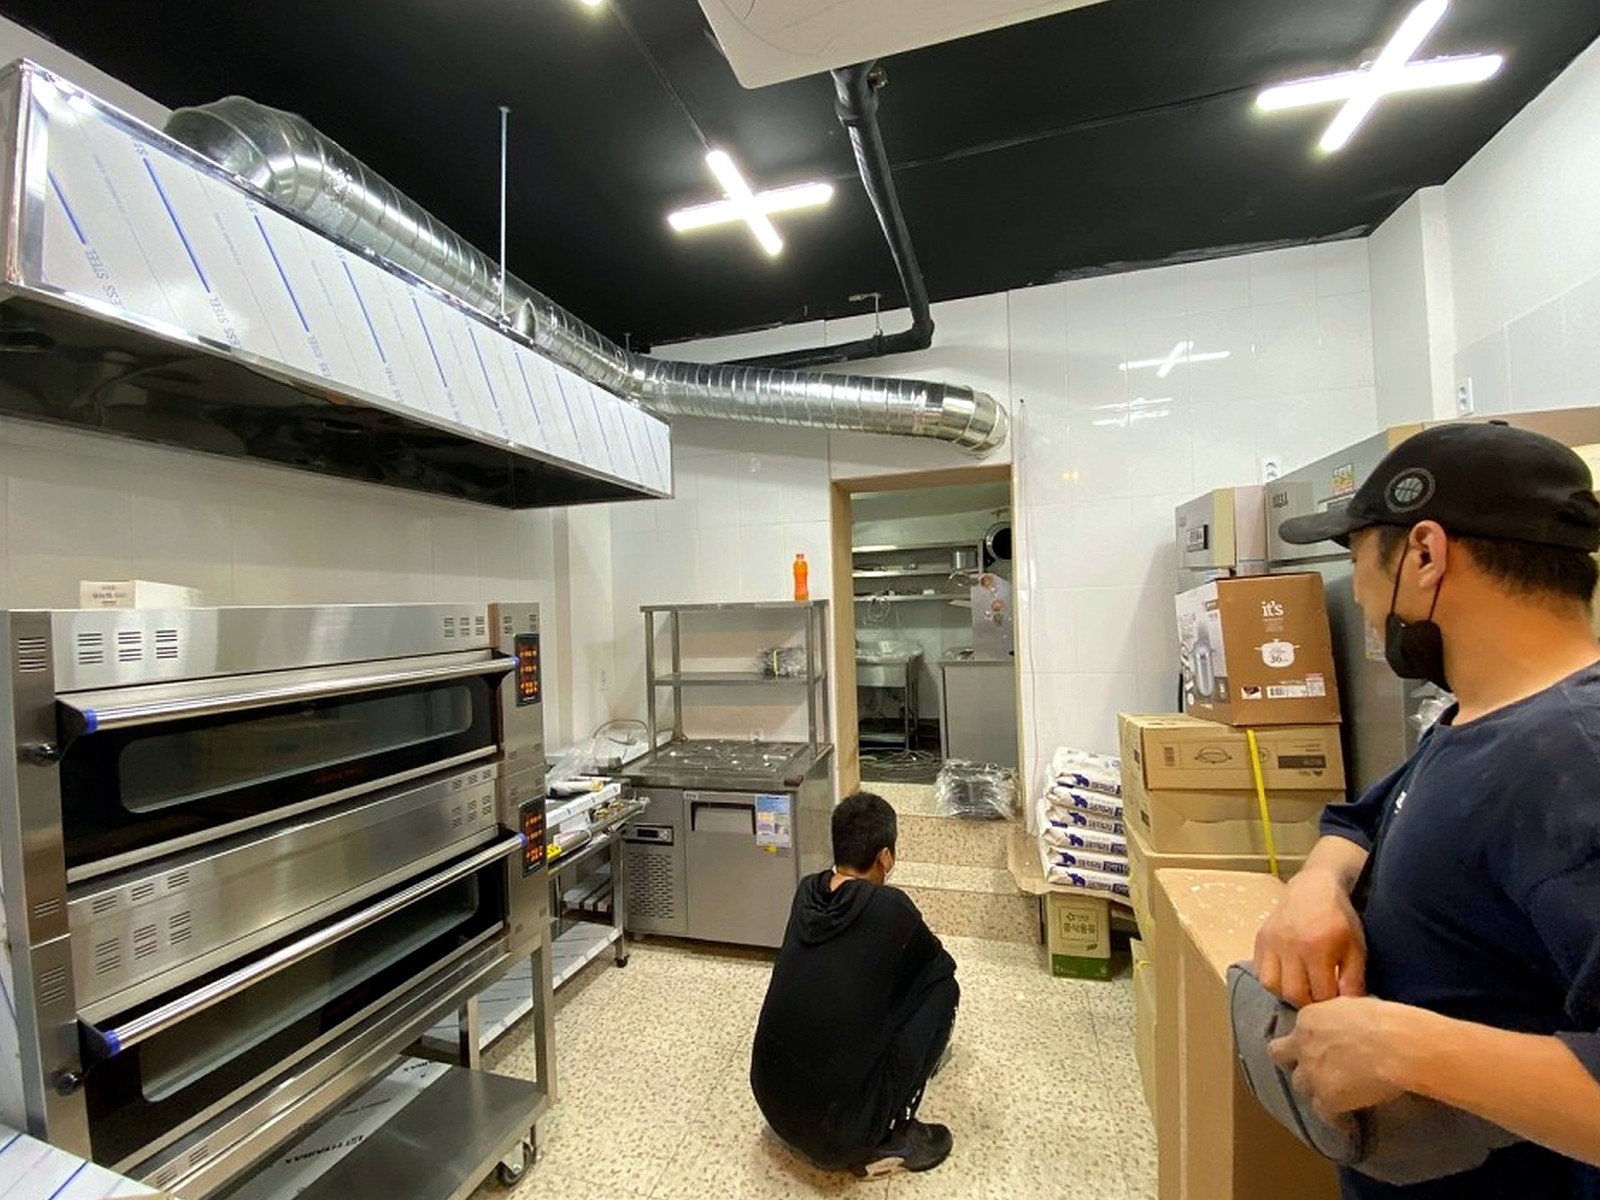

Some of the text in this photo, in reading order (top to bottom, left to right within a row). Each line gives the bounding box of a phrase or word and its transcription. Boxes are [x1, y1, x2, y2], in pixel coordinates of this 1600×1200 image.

[85, 246, 109, 281] STEEL
[209, 293, 230, 326] STEEL
[1261, 600, 1284, 617] it's
